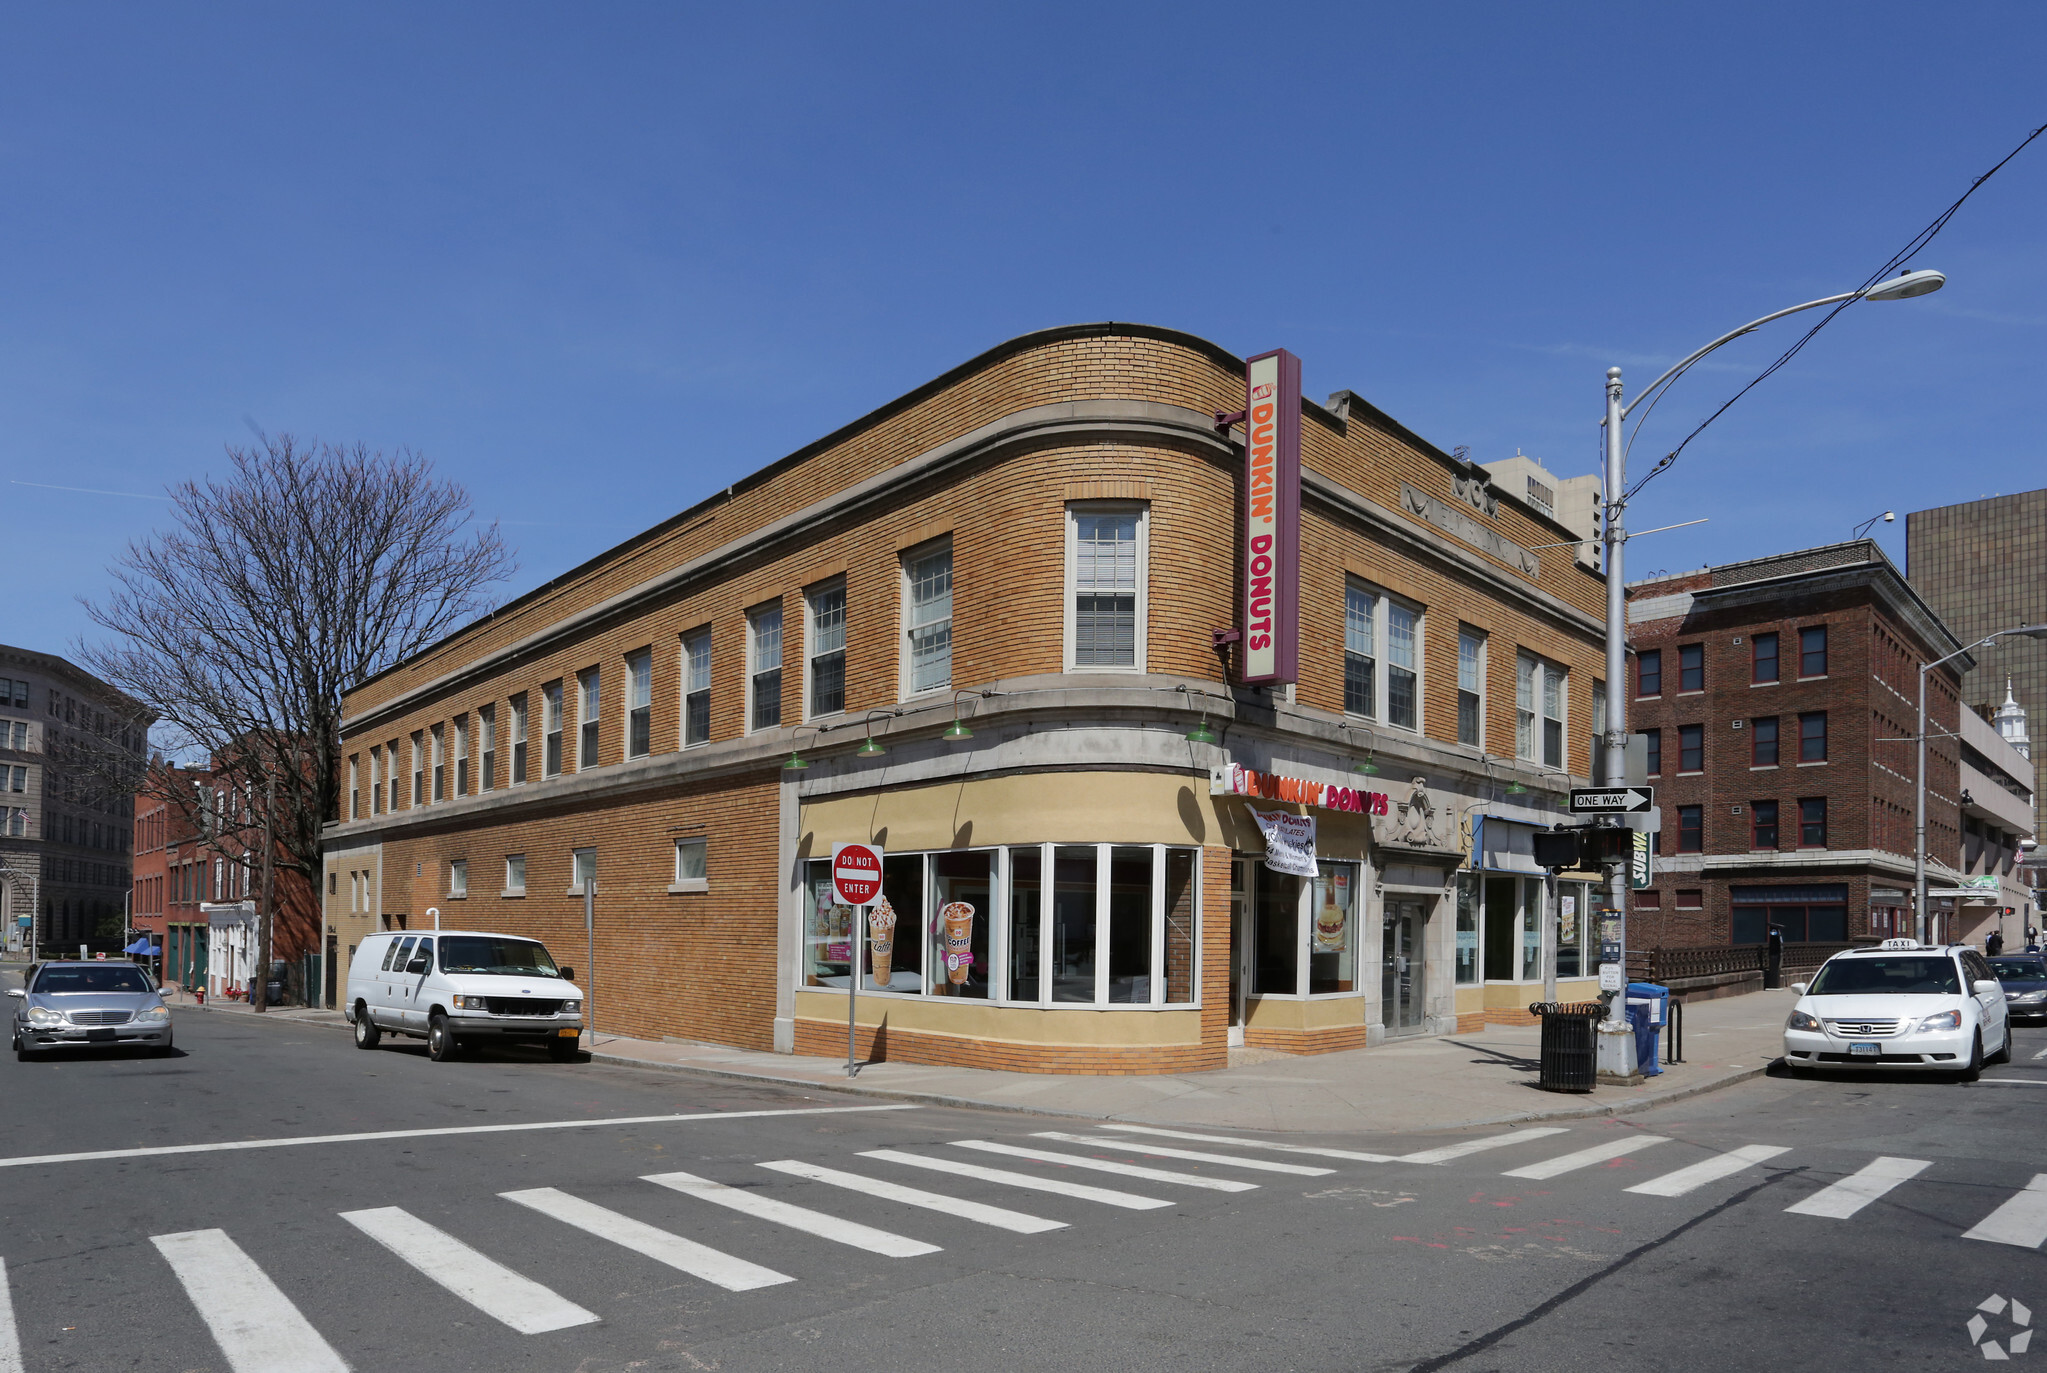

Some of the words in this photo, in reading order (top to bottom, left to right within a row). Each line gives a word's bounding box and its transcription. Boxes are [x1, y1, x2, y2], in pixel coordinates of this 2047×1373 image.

[1250, 402, 1274, 523] DUNKIN'
[1249, 534, 1272, 651] DONUTS
[1247, 769, 1324, 806] DUNKIN'
[1326, 784, 1389, 816] DONUTS
[1577, 795, 1599, 806] ONE
[1602, 795, 1626, 805] WAY
[842, 855, 853, 865] DO
[856, 857, 872, 867] NOT
[844, 883, 870, 894] ENTER
[948, 937, 969, 947] COFFEE
